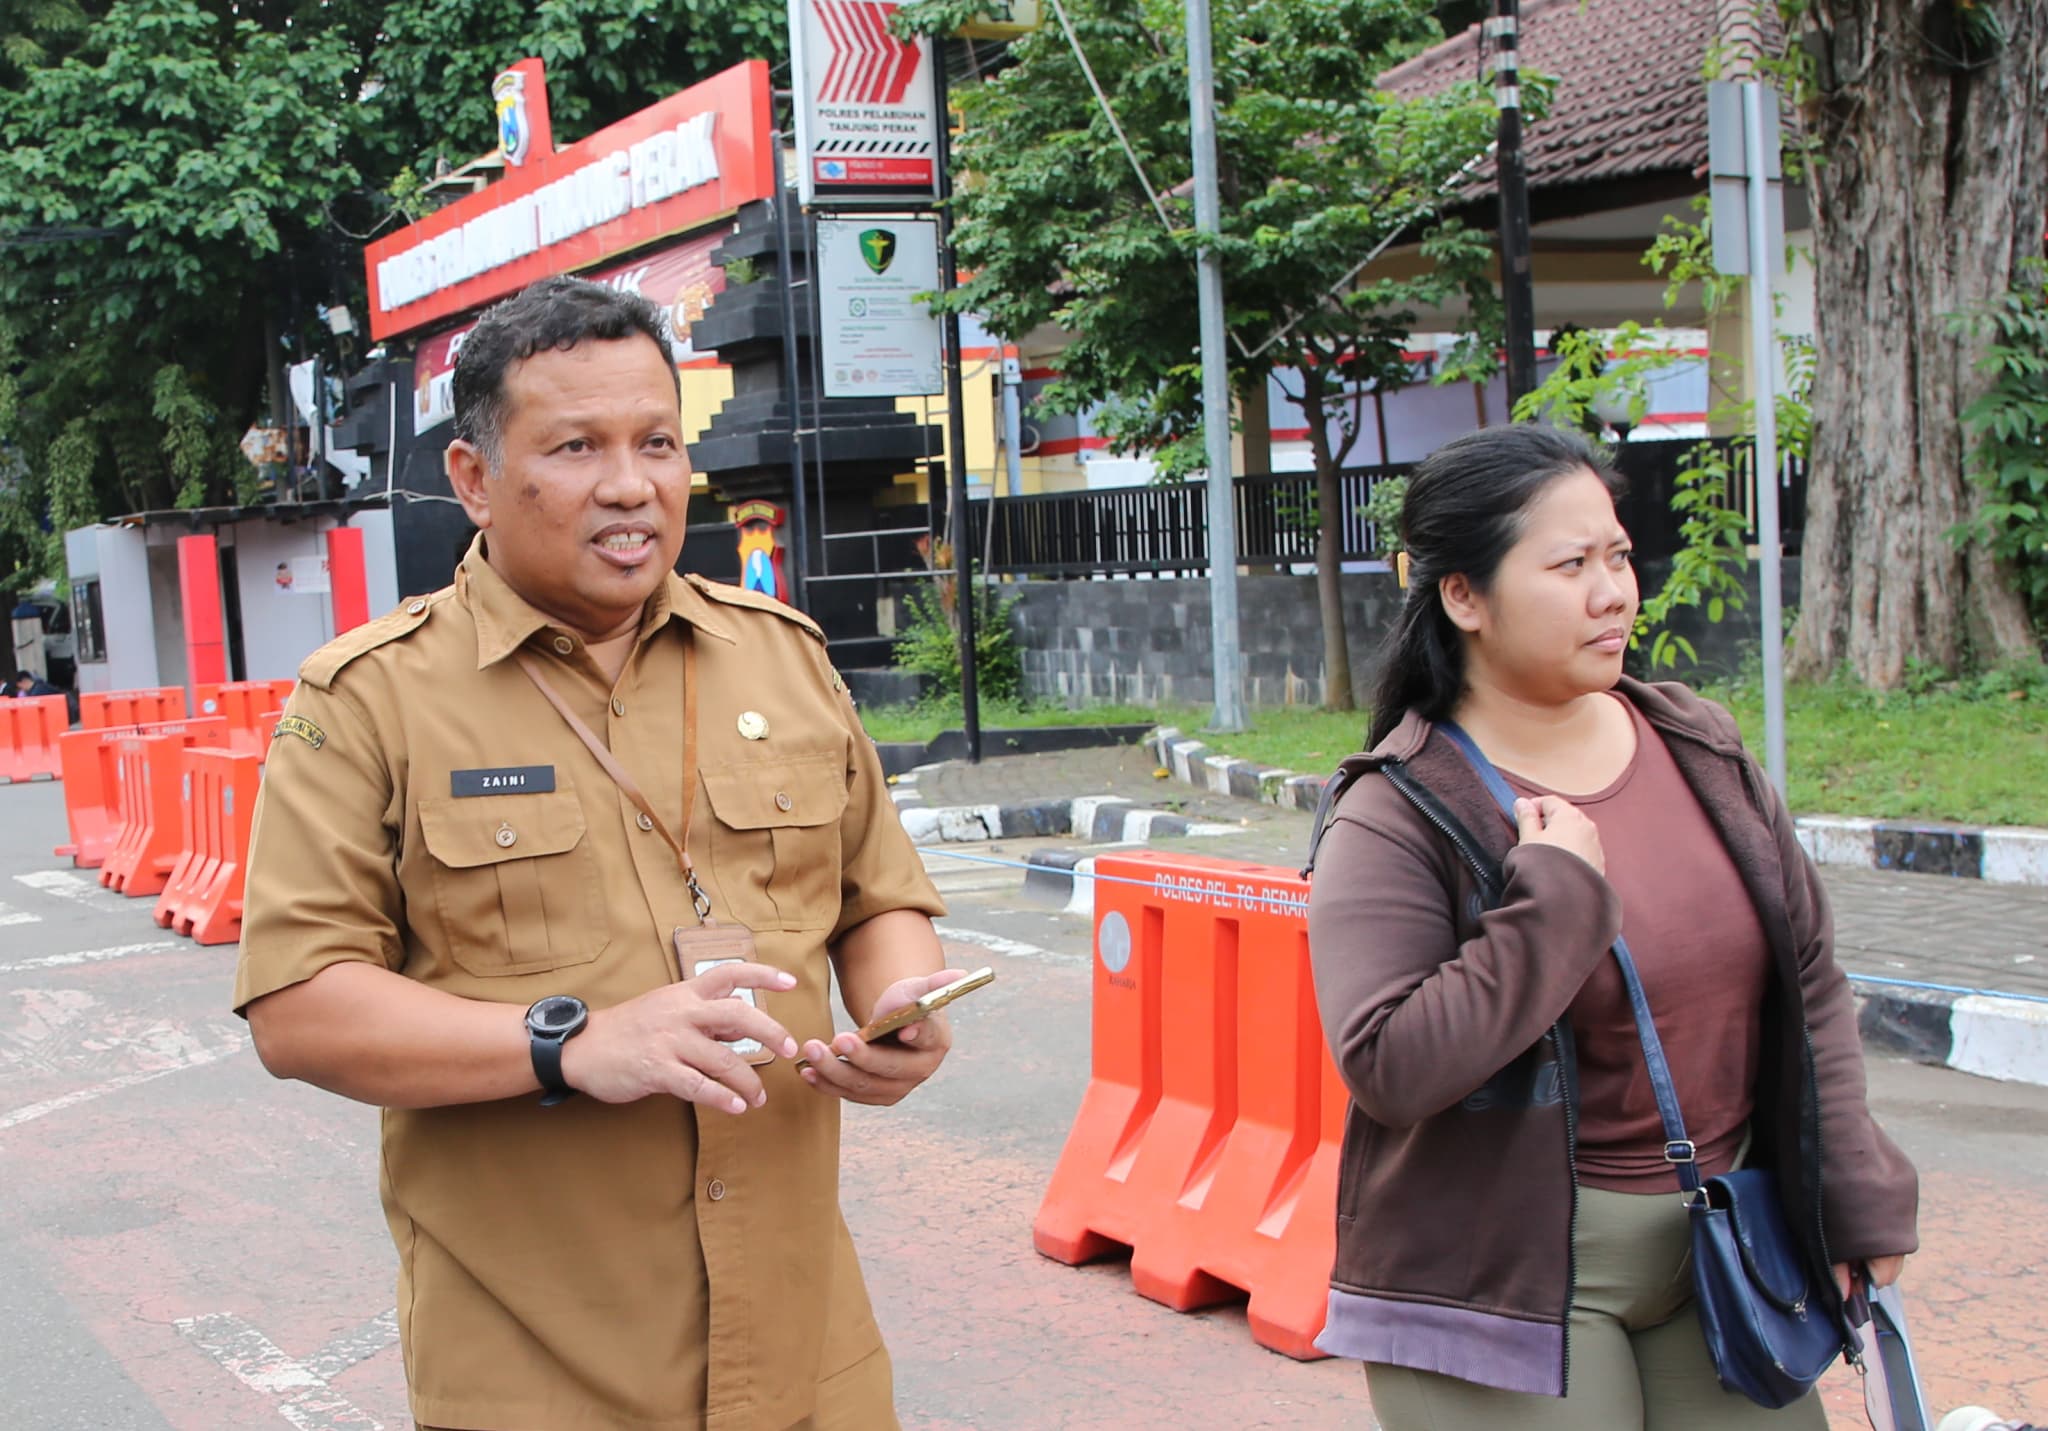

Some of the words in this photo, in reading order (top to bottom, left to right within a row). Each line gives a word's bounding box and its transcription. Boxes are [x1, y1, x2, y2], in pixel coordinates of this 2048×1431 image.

[818, 108, 860, 119] POLRES
[863, 109, 926, 120] PELABUHAN
[829, 122, 880, 133] TANJUNG
[883, 123, 918, 134] PERAK
[482, 774, 526, 788] ZAINI
[1154, 872, 1203, 903] POLRES
[1205, 880, 1233, 909] PEL.
[1236, 883, 1258, 912] TG.
[1260, 886, 1310, 919] PERAK
